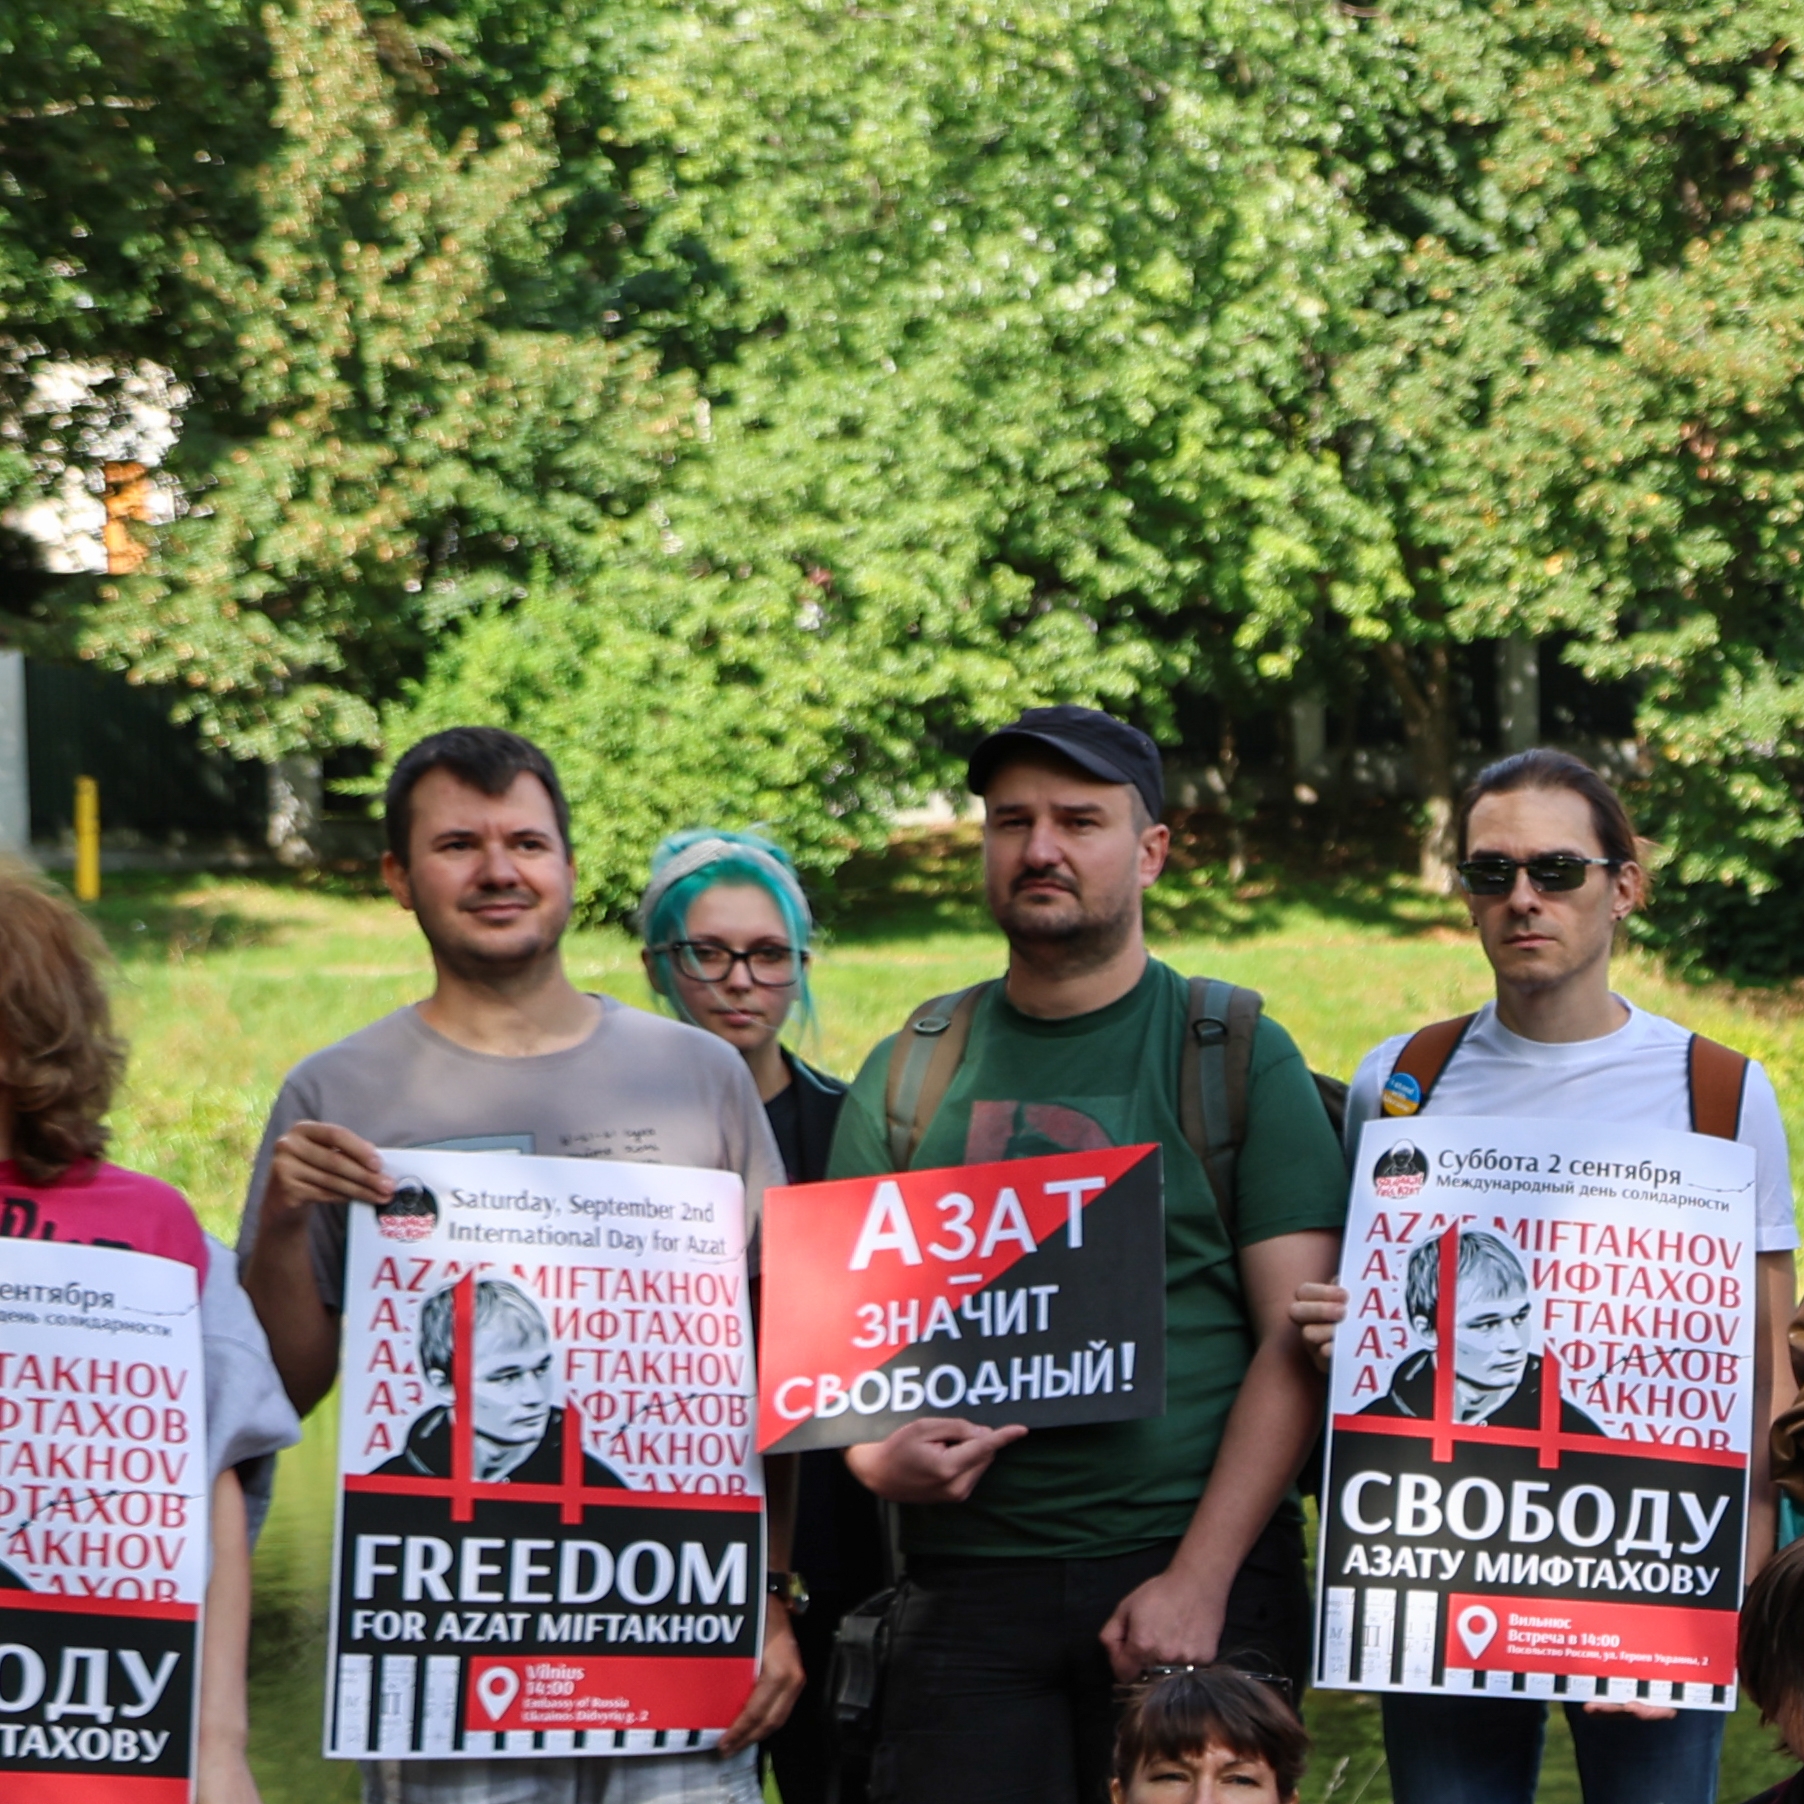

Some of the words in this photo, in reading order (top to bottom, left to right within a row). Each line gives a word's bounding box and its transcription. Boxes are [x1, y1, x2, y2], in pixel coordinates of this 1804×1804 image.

[1437, 1147, 1538, 1175] Суббота
[1547, 1154, 1560, 1173] 2
[1568, 1159, 1681, 1188] сентября
[1435, 1172, 1573, 1195] Международный
[1578, 1184, 1617, 1197] день
[1620, 1186, 1732, 1217] солидарности
[848, 1174, 1107, 1271] АЗАТ
[851, 1283, 1060, 1349] ЗНАЧИТ
[774, 1339, 1137, 1421] СВОБОДНЫЙ!
[1342, 1470, 1728, 1559] СВОБОДУ
[355, 1535, 745, 1604] FREEDOM
[1343, 1544, 1464, 1580] АЗАТУ
[1475, 1550, 1718, 1596] МИФТАХОВУ
[353, 1609, 424, 1640] FOR
[435, 1612, 530, 1641] AZAT
[538, 1613, 742, 1643] MIFTAKHOV
[1507, 1628, 1565, 1645] Встреча
[1568, 1634, 1577, 1644] в
[1581, 1632, 1620, 1647] 14:00
[1509, 1613, 1572, 1629] Вильнюс
[0, 1716, 171, 1764] ТАХОВУ
